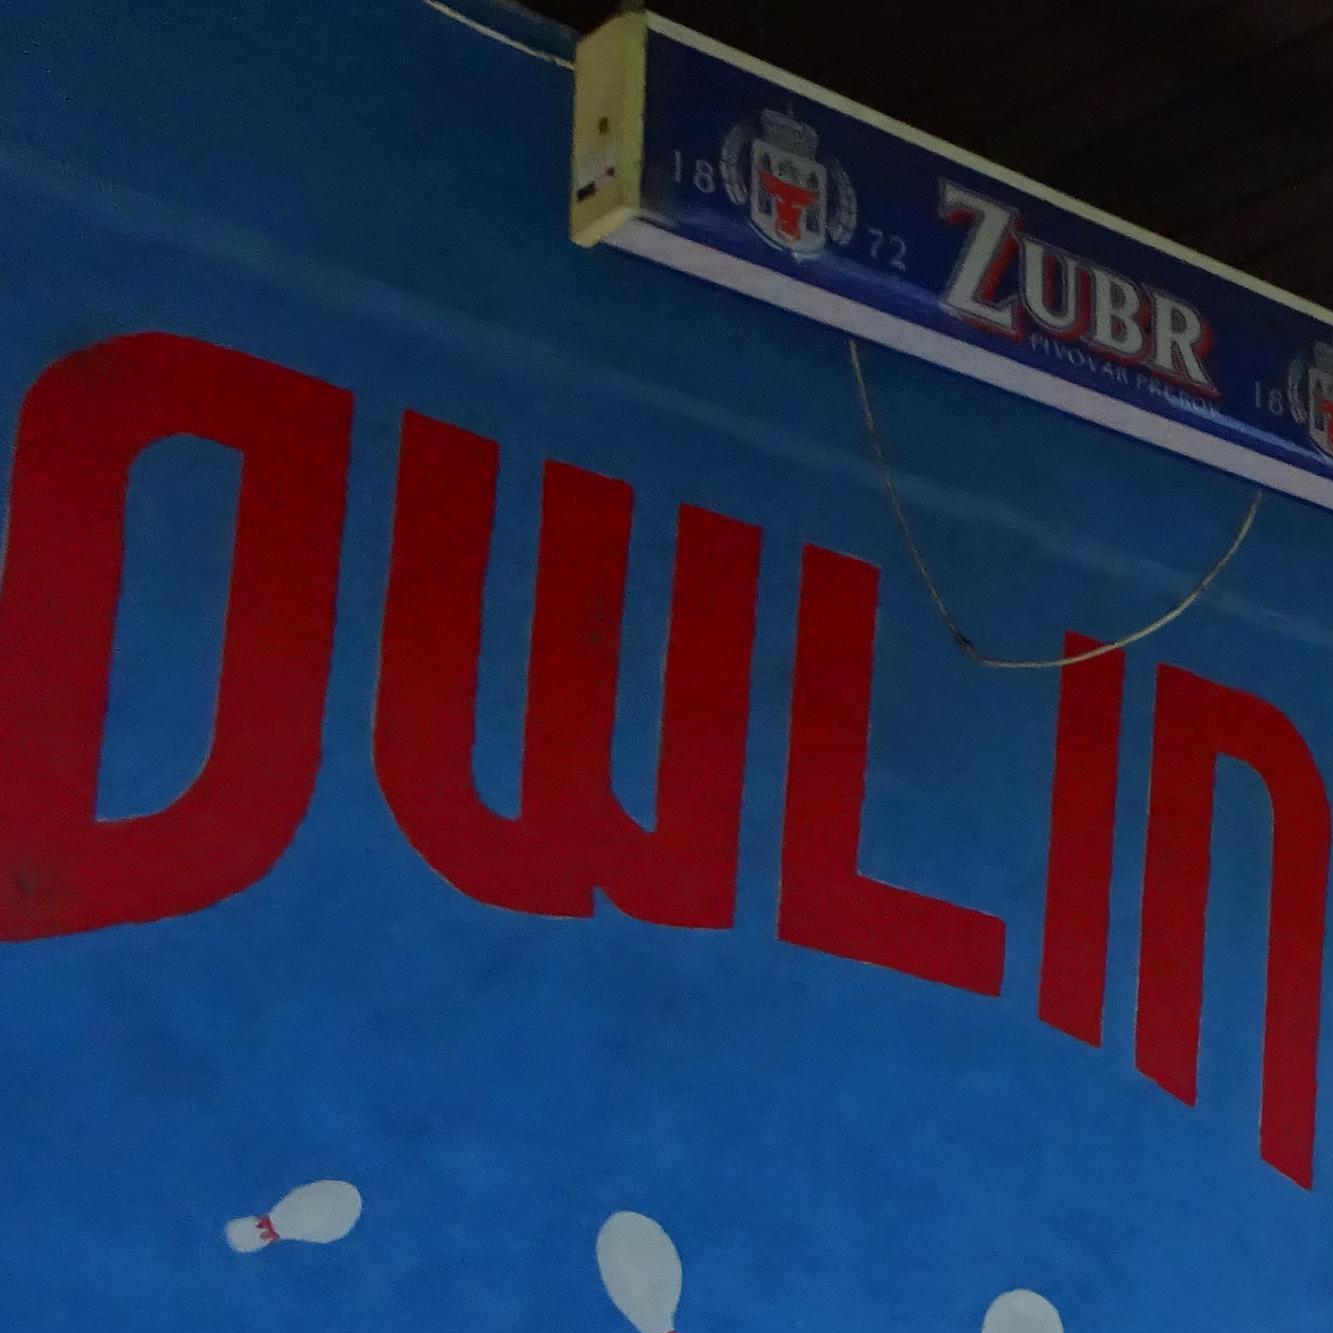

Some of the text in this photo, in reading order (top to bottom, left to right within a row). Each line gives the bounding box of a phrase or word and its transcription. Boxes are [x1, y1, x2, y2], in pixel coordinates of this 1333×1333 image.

[673, 149, 907, 271] 18 72
[938, 180, 1220, 397] ZUBR
